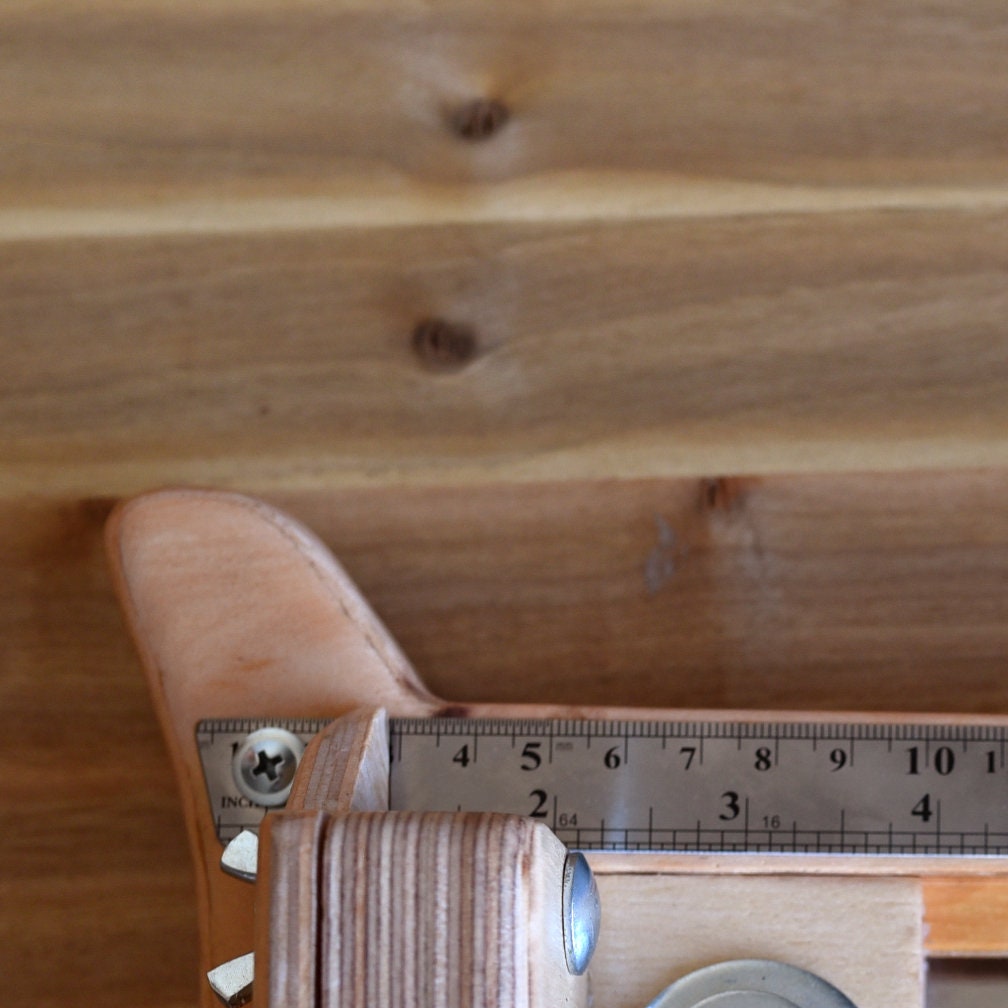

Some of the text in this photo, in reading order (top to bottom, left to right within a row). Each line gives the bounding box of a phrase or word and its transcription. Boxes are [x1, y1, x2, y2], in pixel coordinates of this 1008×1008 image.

[452, 743, 470, 768] 4
[520, 742, 542, 772] 5
[603, 745, 621, 770] 6
[679, 746, 697, 771] 7
[754, 747, 772, 771] 8
[829, 747, 847, 772] 9
[904, 747, 955, 776] 10
[529, 789, 549, 818] 2
[718, 791, 741, 821] 3
[910, 794, 933, 823] 4
[558, 813, 578, 826] 64
[762, 815, 780, 829] 16
